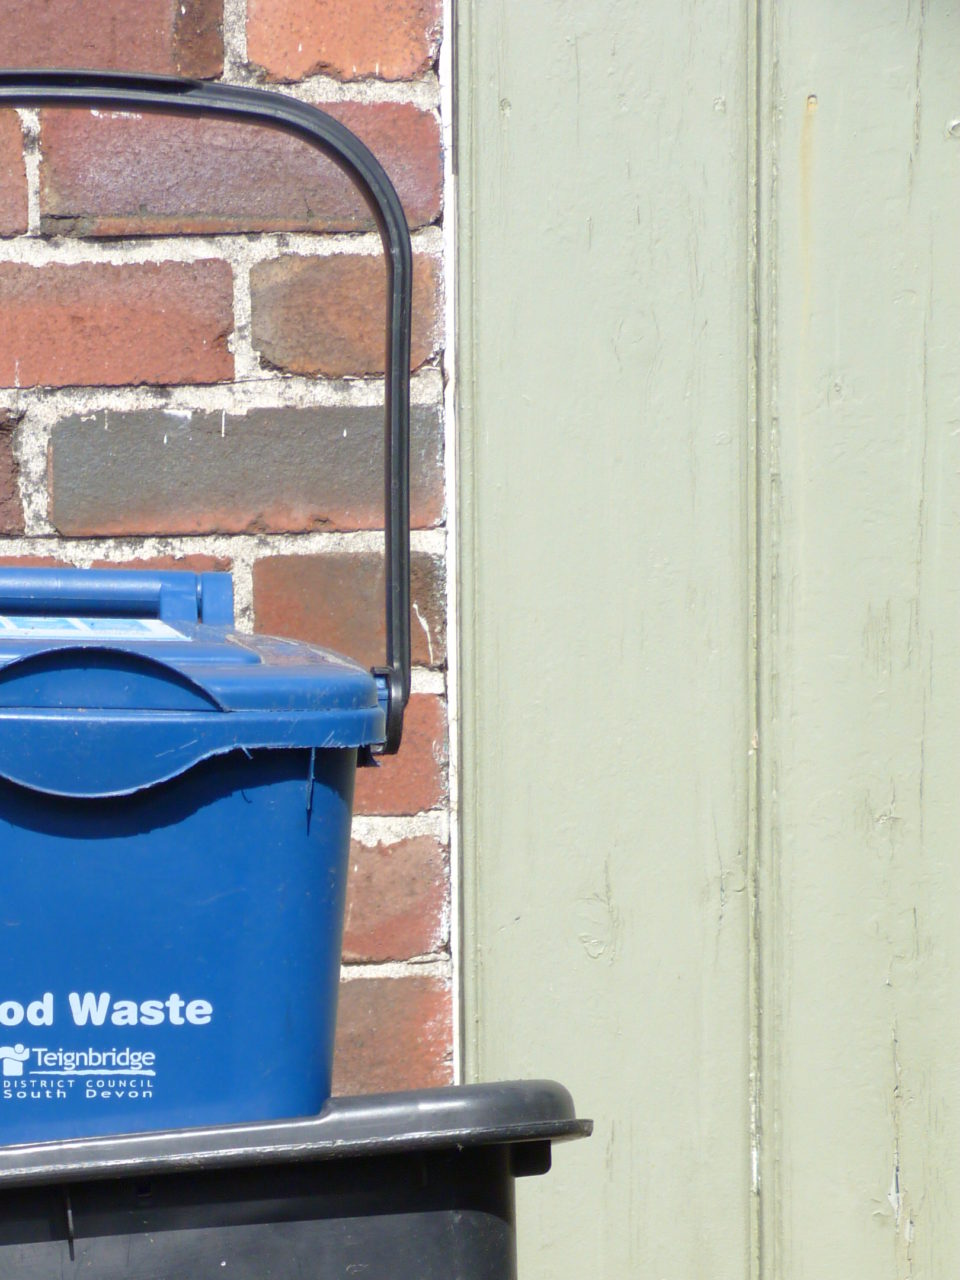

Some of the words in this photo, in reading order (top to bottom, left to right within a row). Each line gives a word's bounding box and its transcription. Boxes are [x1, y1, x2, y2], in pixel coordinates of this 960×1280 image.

[68, 992, 213, 1026] Waste
[32, 1048, 155, 1070] Teignbridge
[3, 1080, 75, 1088] DISTRICT
[86, 1080, 153, 1088] COUNCIL
[3, 1088, 66, 1098] South
[86, 1088, 153, 1098] Devon
